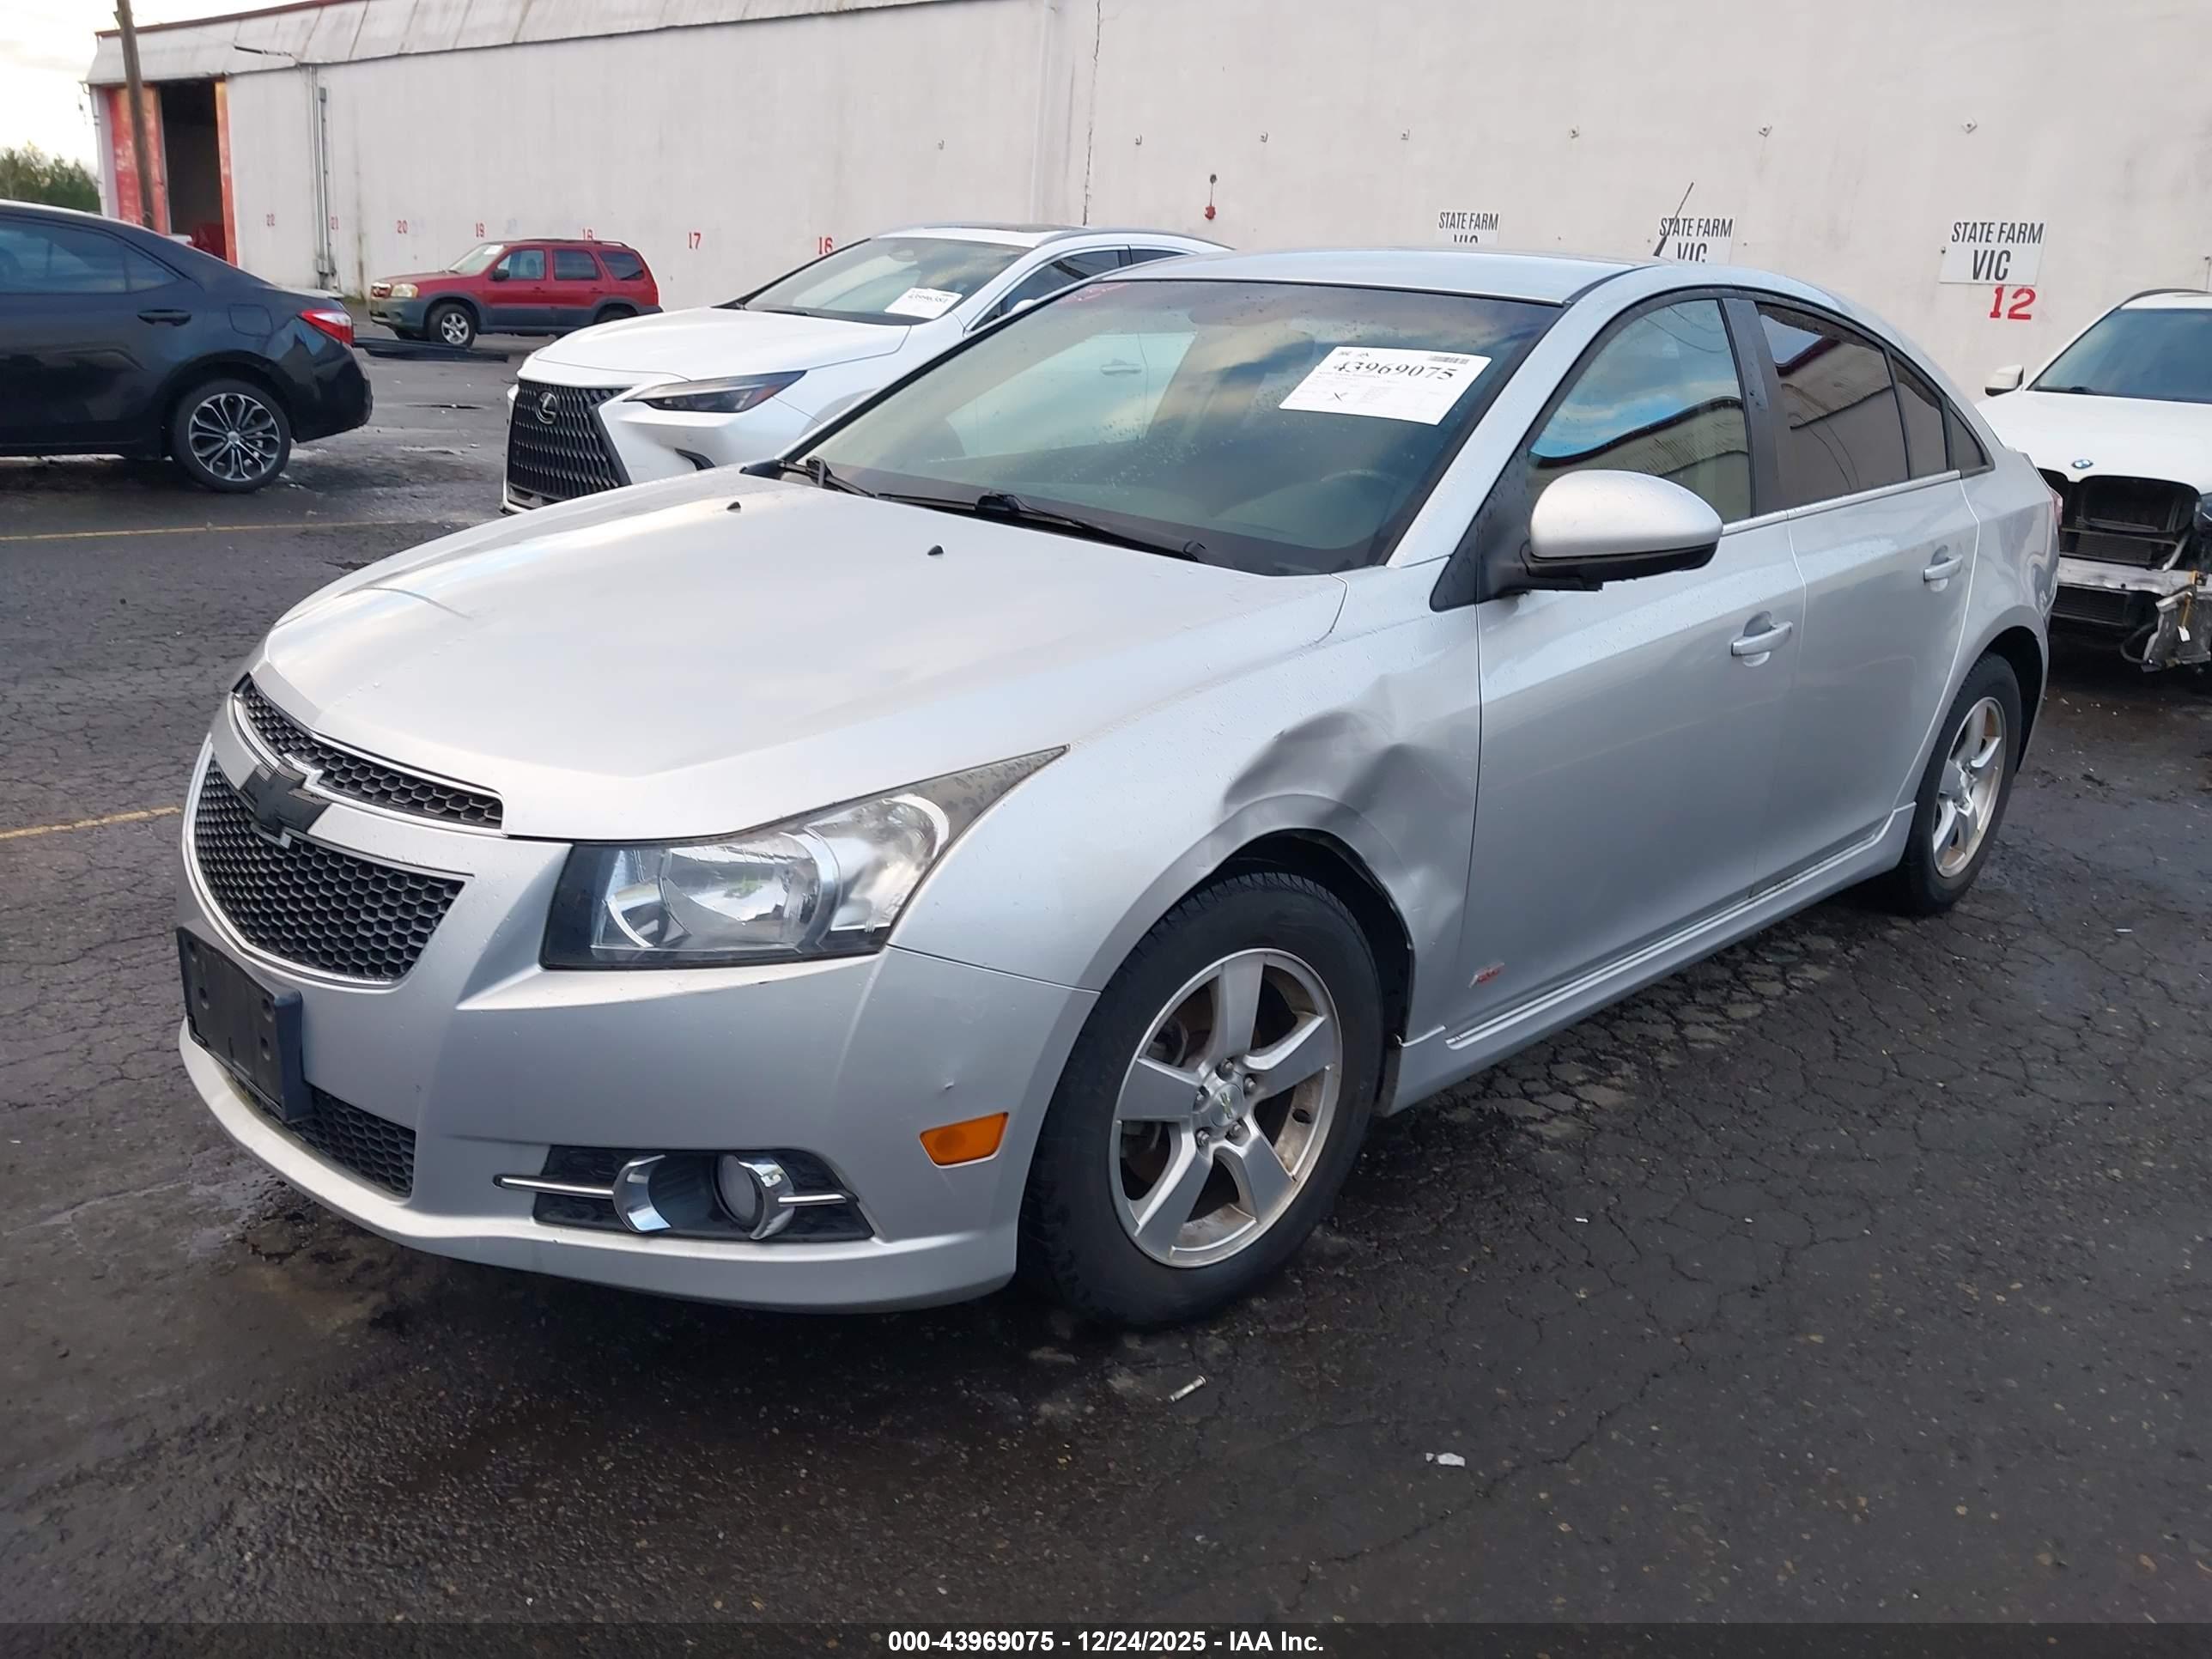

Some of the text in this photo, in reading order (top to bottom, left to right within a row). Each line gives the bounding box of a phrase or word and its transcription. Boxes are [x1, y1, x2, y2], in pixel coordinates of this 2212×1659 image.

[397, 219, 409, 234] 20
[1438, 211, 1499, 231] STATE FARM
[1659, 217, 1734, 238] STATE FARM
[688, 232, 702, 250] 17
[1951, 222, 2045, 245] STATE FARM
[817, 236, 834, 255] 16
[1972, 249, 2012, 281] VIC
[1990, 285, 2036, 320] 12
[1333, 360, 1459, 380] 43969075
